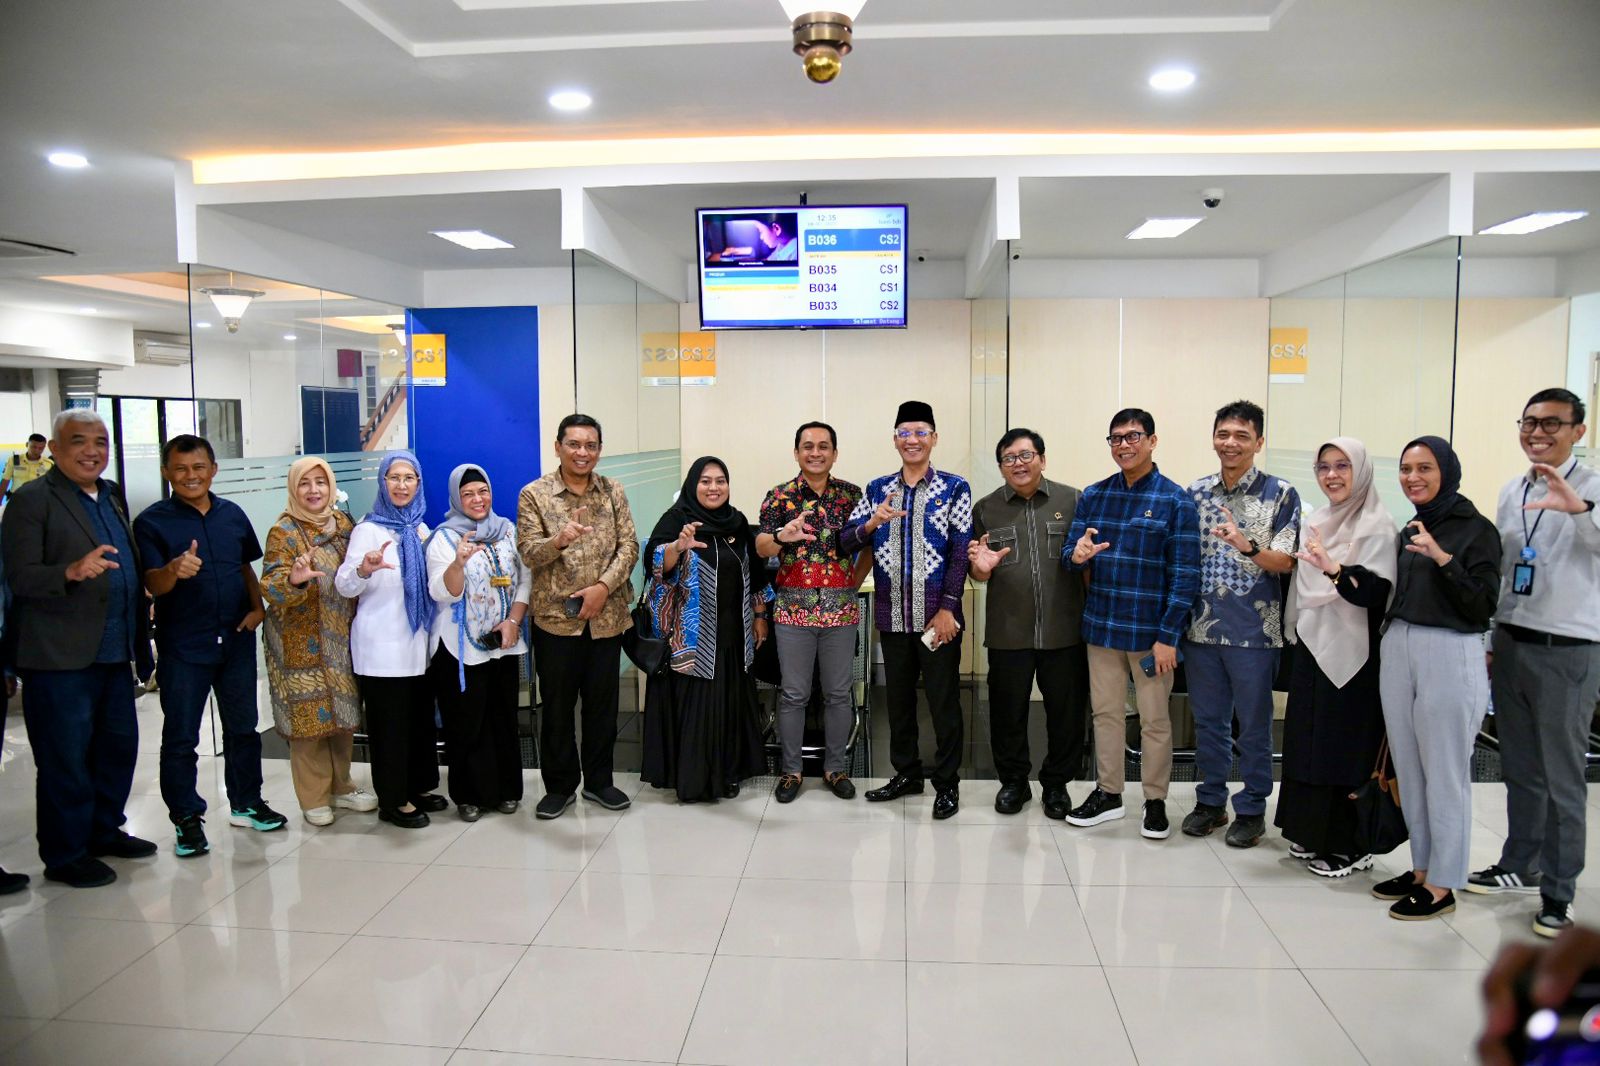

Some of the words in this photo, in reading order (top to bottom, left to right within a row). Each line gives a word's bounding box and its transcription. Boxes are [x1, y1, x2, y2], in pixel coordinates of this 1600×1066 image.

[808, 234, 838, 246] B036
[879, 233, 900, 245] CS2
[809, 265, 838, 275] B035
[879, 264, 898, 274] CS1
[809, 283, 837, 293] B034
[879, 282, 898, 292] CS1
[809, 301, 838, 311] B033
[879, 300, 899, 310] CS2
[414, 347, 444, 364] CS1
[1270, 343, 1308, 359] CS4
